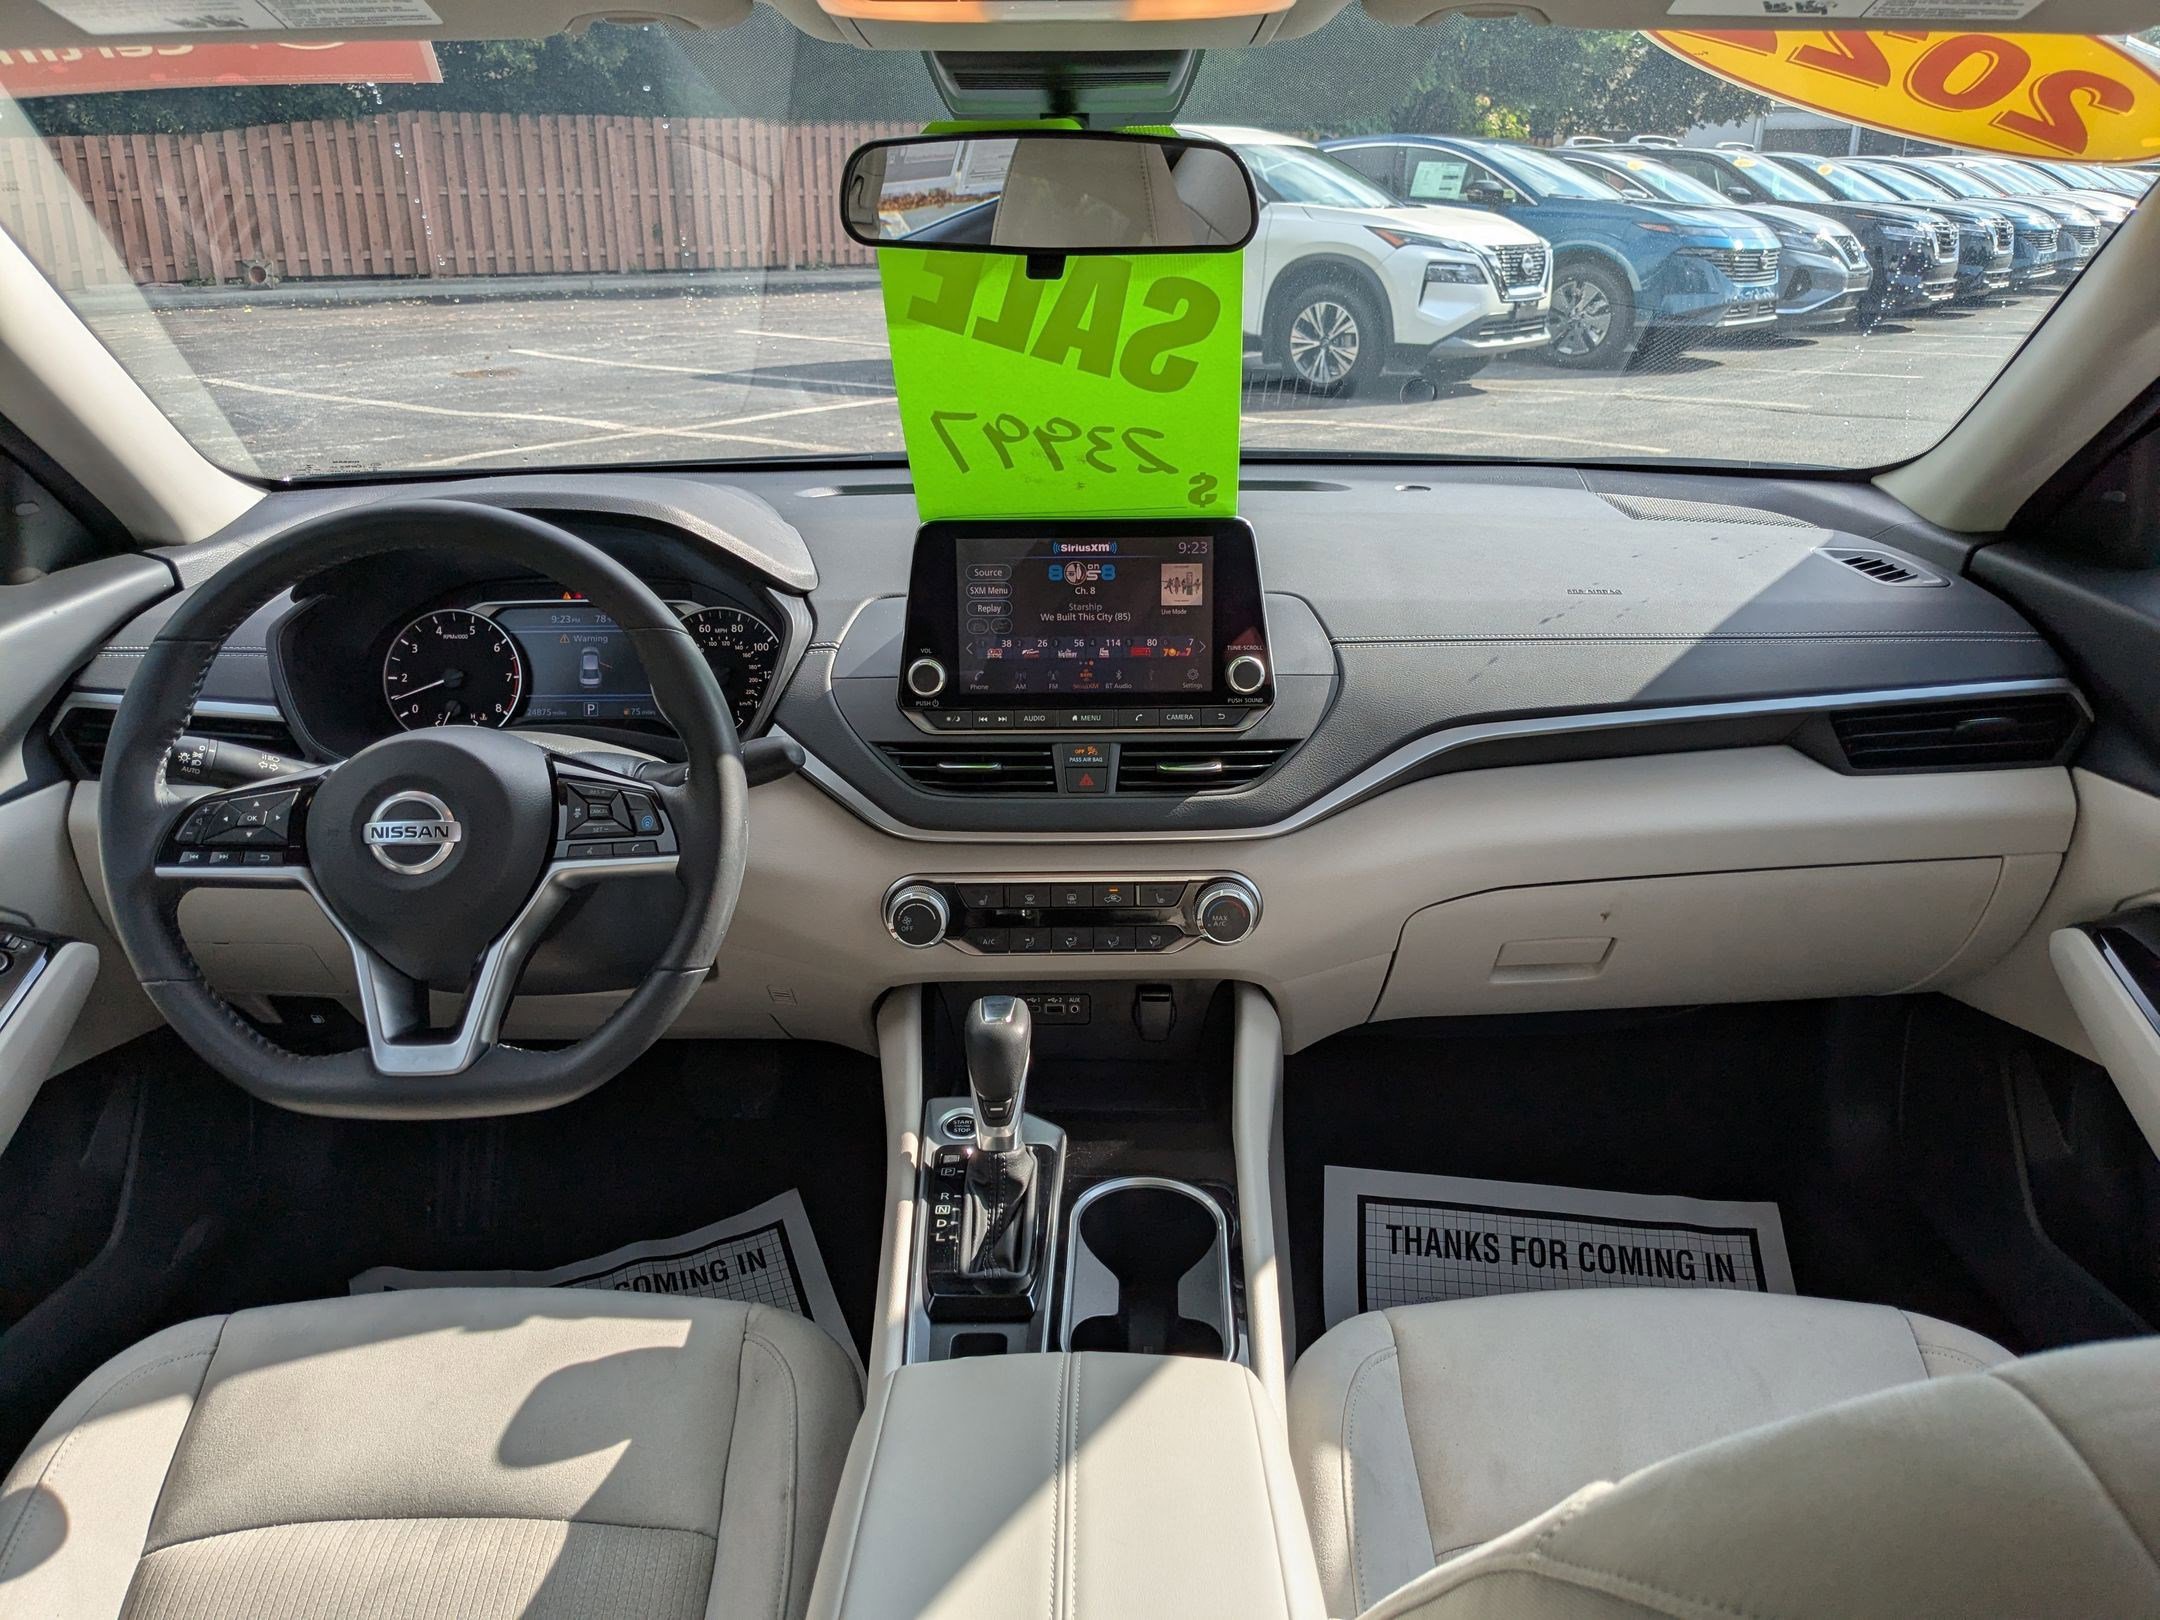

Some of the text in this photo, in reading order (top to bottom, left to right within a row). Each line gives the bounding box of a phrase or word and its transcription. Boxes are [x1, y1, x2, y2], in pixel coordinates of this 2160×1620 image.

[1178, 541, 1208, 554] 9:23
[974, 568, 1003, 577] Source
[969, 586, 1008, 595] SXM Menu
[1074, 586, 1096, 595] Ch. 8
[977, 604, 1002, 614] Replay
[1068, 602, 1103, 612] Starship
[1040, 612, 1131, 622] We Built This City (85)
[435, 626, 442, 635] 4
[469, 625, 476, 635] 5
[698, 624, 711, 633] 60
[731, 624, 744, 633] 80
[573, 634, 608, 644] Warning
[1001, 639, 1012, 648] 38
[1037, 639, 1048, 648] 26
[1074, 639, 1085, 647] 56
[1106, 639, 1121, 647] 114
[1146, 638, 1158, 647] 80
[1188, 638, 1194, 646] 7
[411, 643, 418, 654] 3
[493, 643, 500, 653] 6
[753, 642, 769, 652] 100
[401, 673, 408, 683] 2
[505, 673, 512, 682] 7
[411, 704, 418, 713] 0
[495, 703, 502, 713] 8
[587, 703, 595, 715] P
[1023, 714, 1046, 722] AUDIO
[1081, 714, 1101, 722] MENU
[1166, 713, 1194, 721] CAMERA
[181, 765, 201, 775] AUTO
[371, 825, 449, 839] NISSAN
[901, 925, 914, 933] OFF
[982, 937, 996, 946] A/C
[940, 1192, 950, 1200] R
[936, 1219, 947, 1228] D
[935, 1233, 946, 1242] L
[1385, 1223, 1737, 1283] THANKS FOR COMING IN
[739, 1247, 768, 1276] IN
